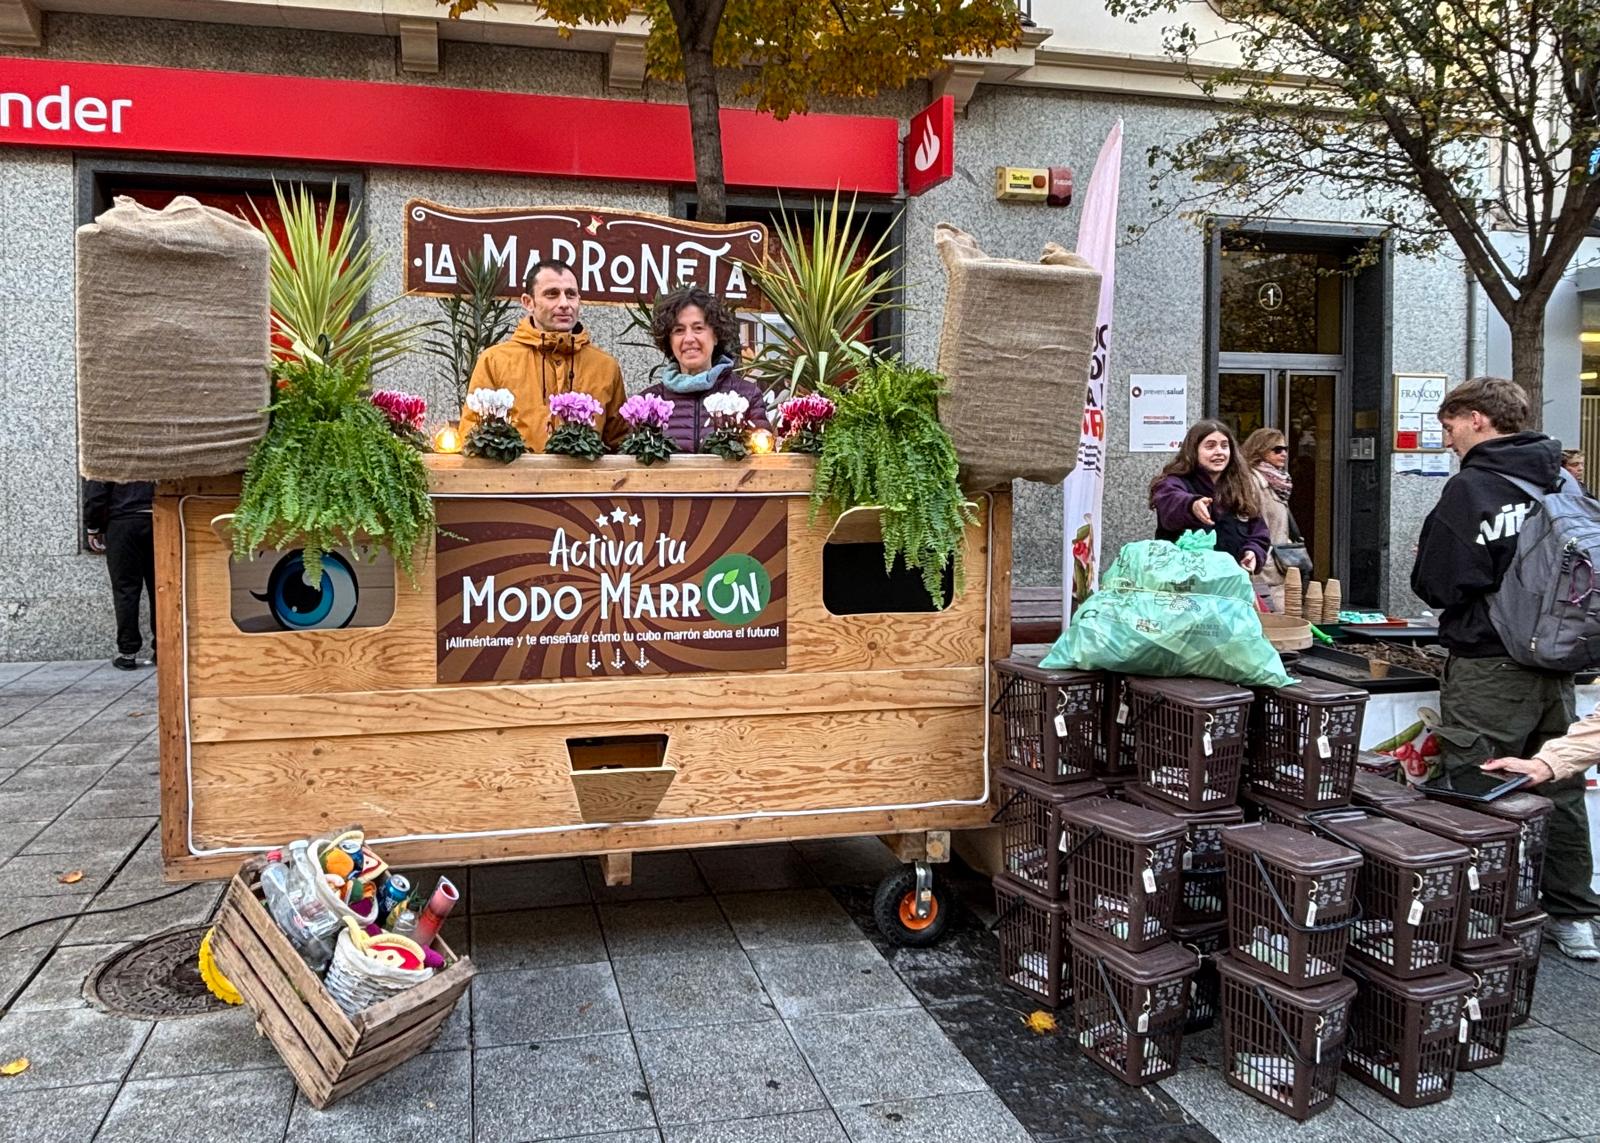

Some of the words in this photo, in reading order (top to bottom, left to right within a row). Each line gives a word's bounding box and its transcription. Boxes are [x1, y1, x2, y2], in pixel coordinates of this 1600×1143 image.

[0, 85, 133, 133] nder
[424, 243, 457, 283] LA
[1267, 287, 1274, 306] 1
[549, 527, 644, 572] Activa
[656, 532, 685, 567] tu
[462, 575, 583, 624] MODO
[446, 635, 514, 650] ¡Aliméntame
[517, 637, 524, 648] y
[526, 633, 536, 646] te
[540, 631, 589, 644] enseñaré
[592, 630, 621, 643] cómo
[623, 630, 634, 642] tu
[637, 629, 660, 642] cubo
[664, 627, 700, 641] marrón
[703, 627, 732, 640] abona
[735, 626, 744, 639] el
[747, 626, 779, 639] futuro!
